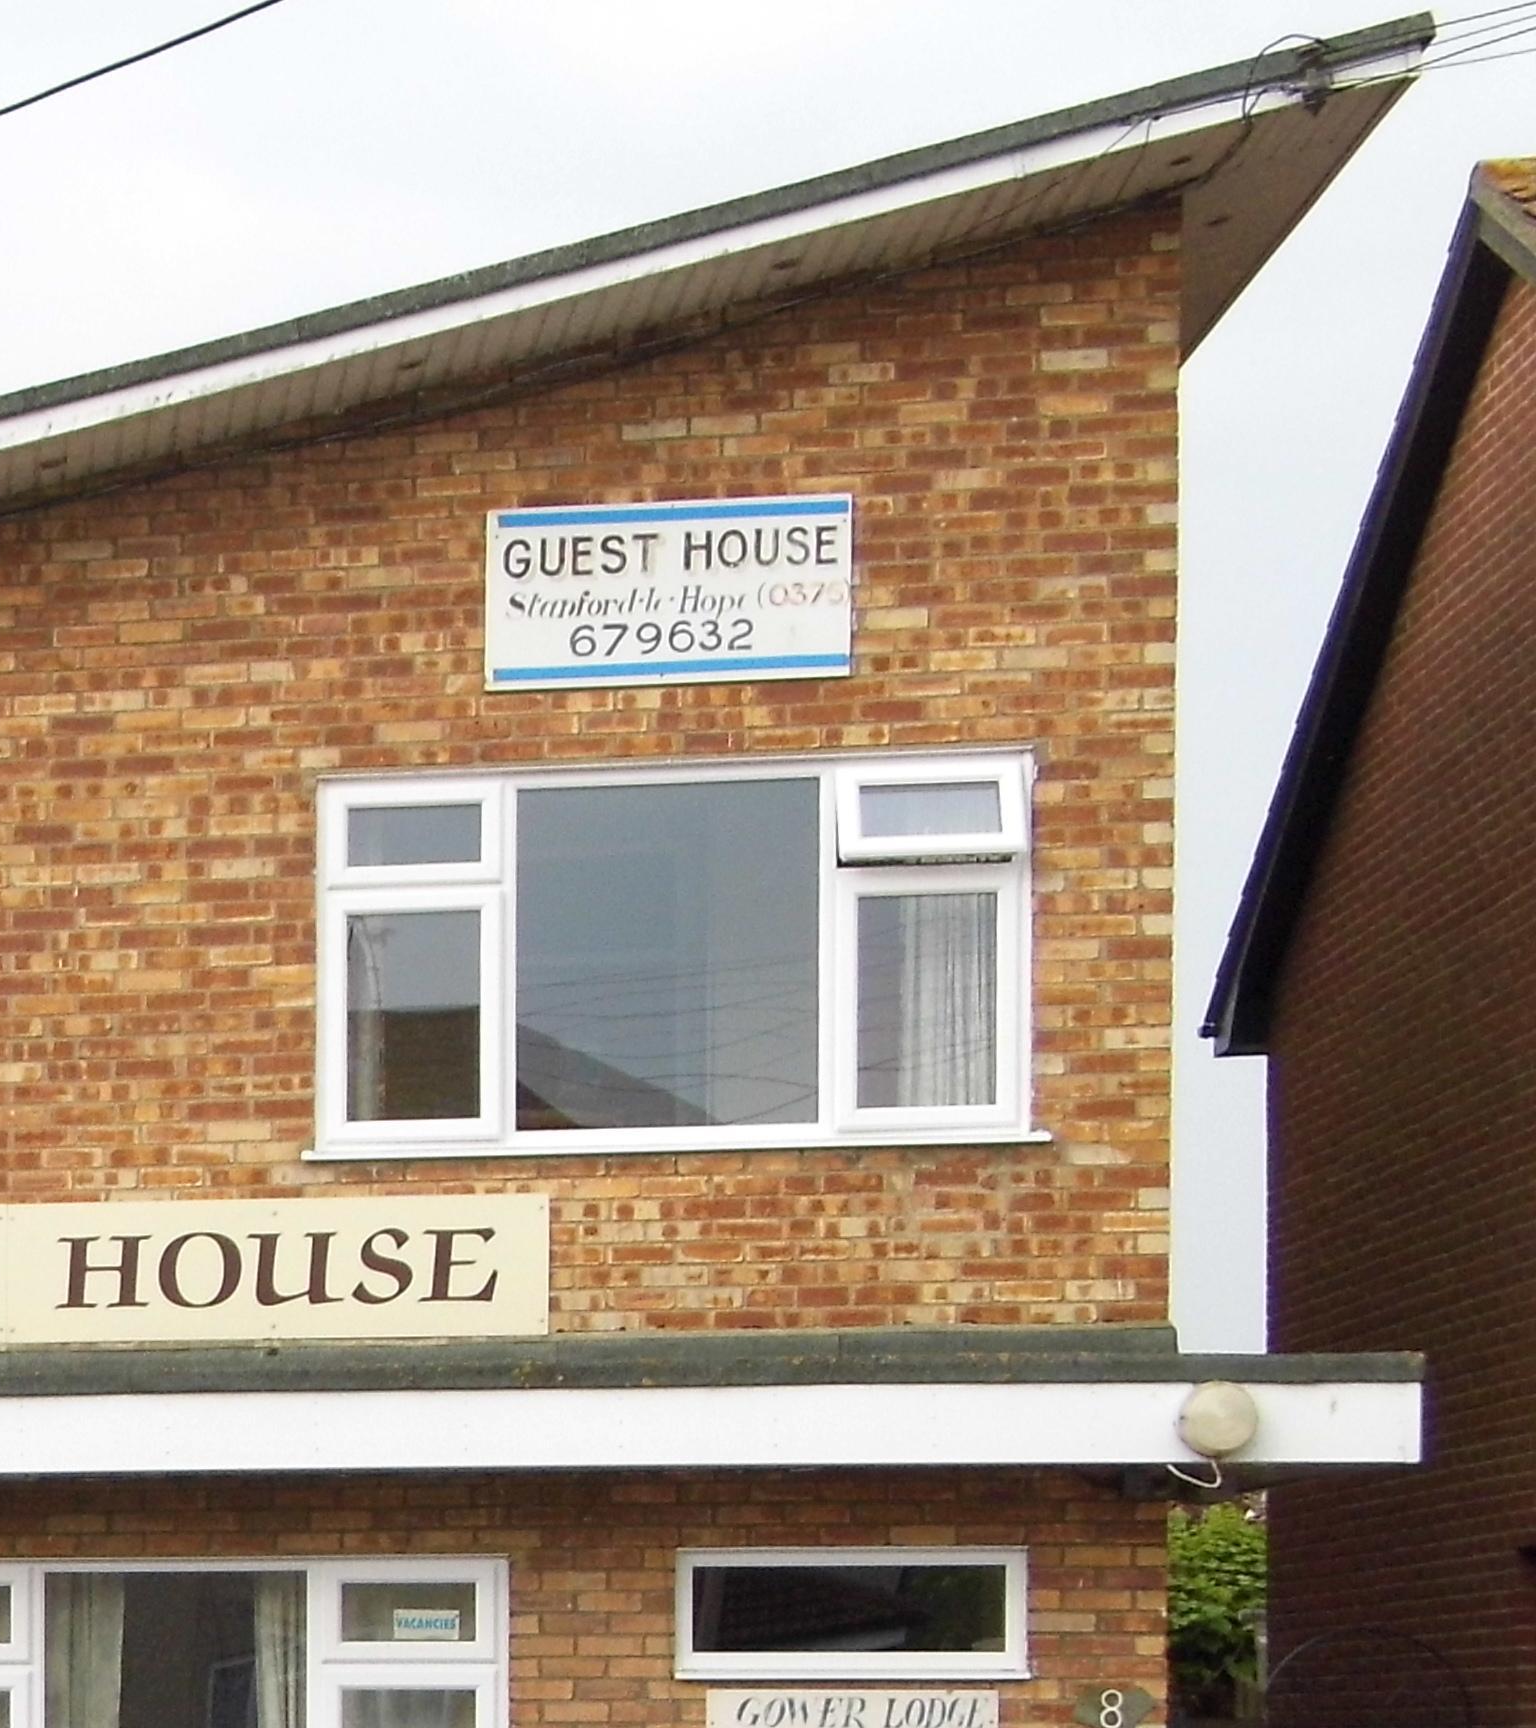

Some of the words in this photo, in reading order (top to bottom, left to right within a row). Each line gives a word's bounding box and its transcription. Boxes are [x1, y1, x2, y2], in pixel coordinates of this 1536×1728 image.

[503, 532, 659, 579] GUEST
[683, 524, 838, 571] HOUSE
[569, 618, 754, 657] 679632
[55, 1226, 499, 1309] HOUSE
[394, 1616, 456, 1630] VACANCIES
[884, 1697, 986, 1728] LODGE
